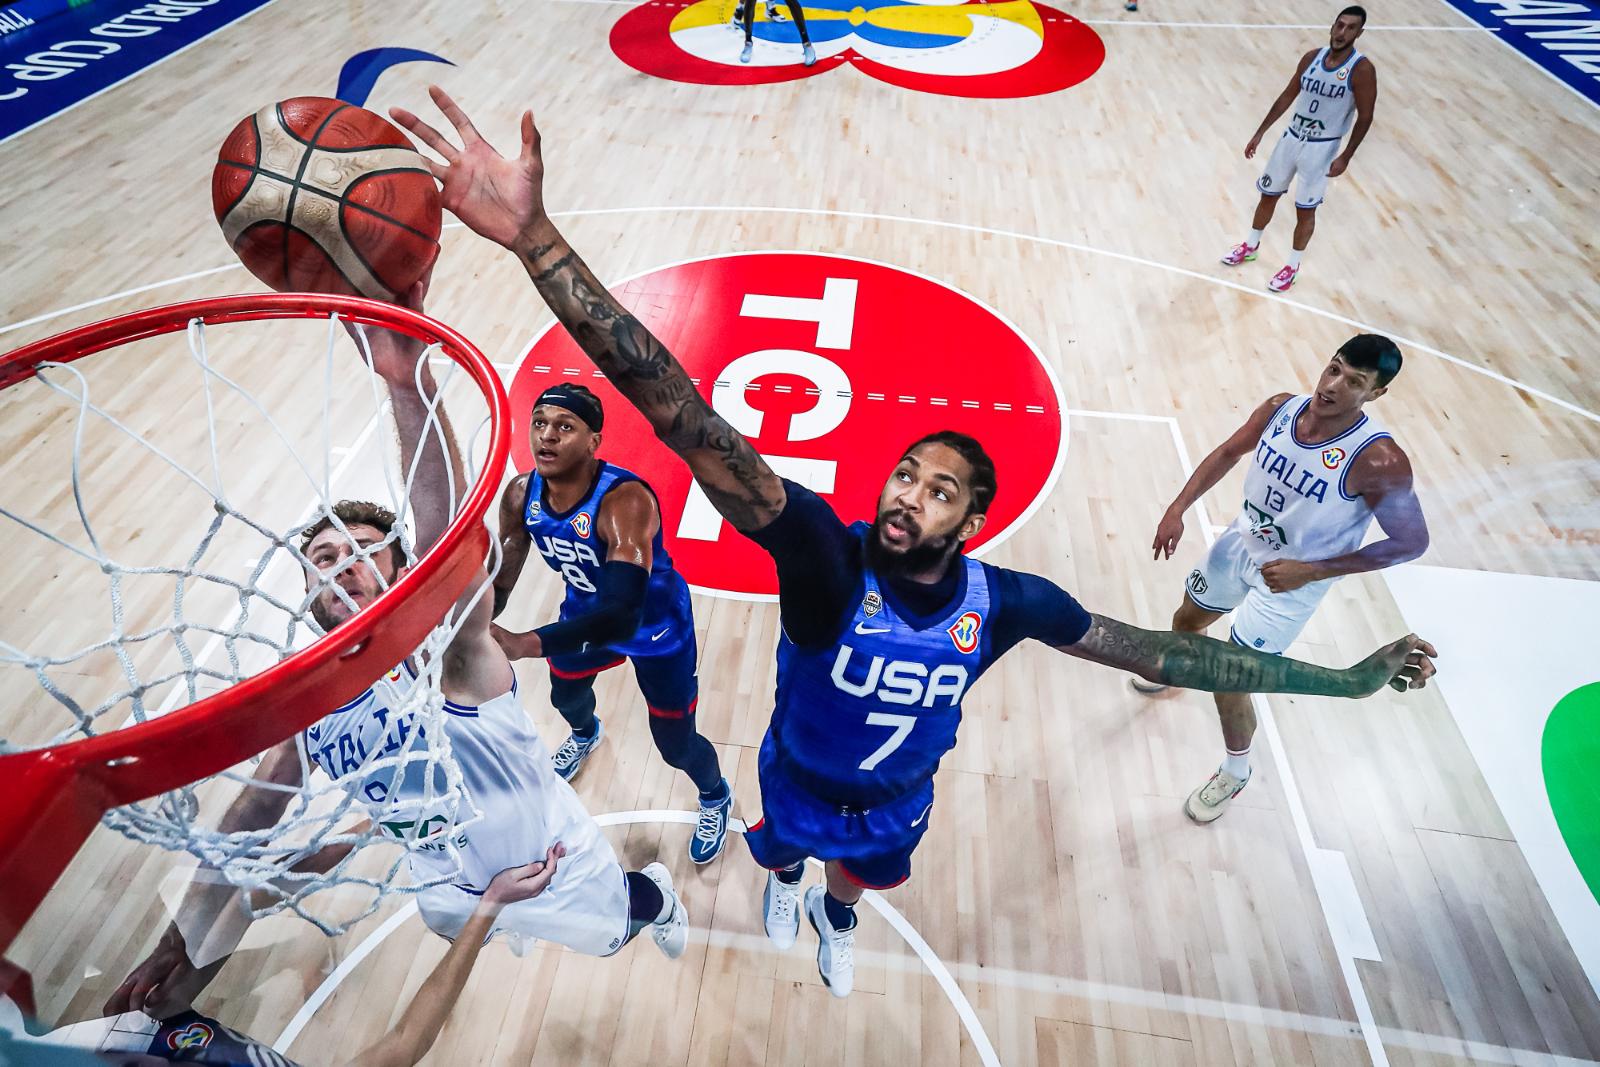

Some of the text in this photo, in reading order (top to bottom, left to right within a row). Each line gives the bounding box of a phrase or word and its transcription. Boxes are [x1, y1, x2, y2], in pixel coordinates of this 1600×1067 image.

[0, 8, 35, 36] ALL
[5, 40, 121, 81] CUP
[1300, 76, 1346, 98] ITALIA
[1309, 99, 1319, 114] 0
[1256, 439, 1328, 504] ITALIA
[1264, 484, 1285, 512] 13
[530, 532, 600, 568] USA
[561, 563, 597, 594] 8
[830, 645, 969, 708] USA
[857, 712, 918, 772] 7
